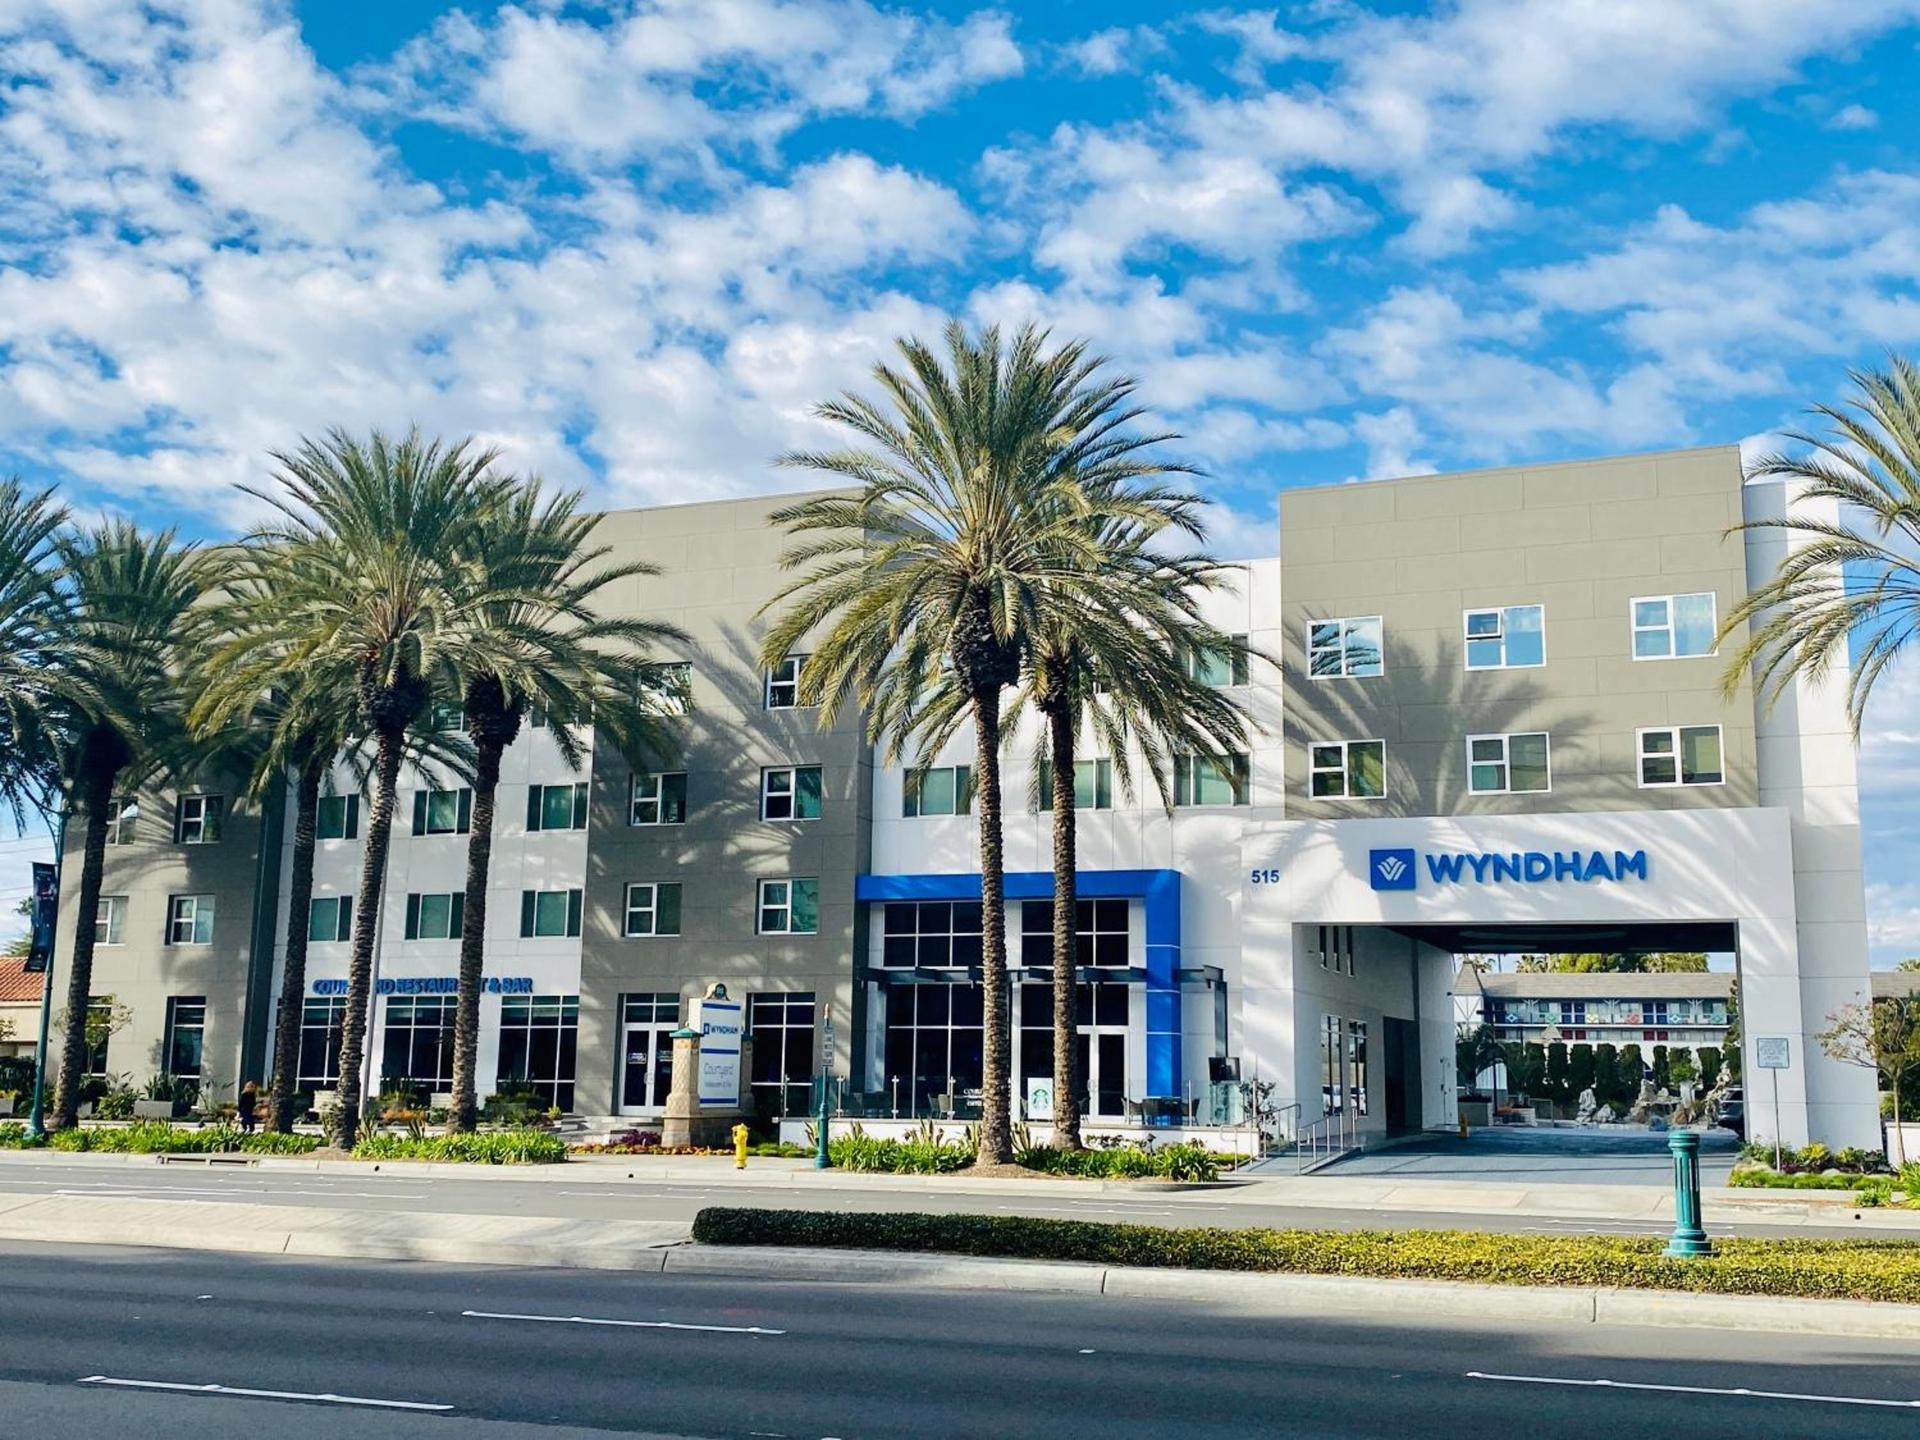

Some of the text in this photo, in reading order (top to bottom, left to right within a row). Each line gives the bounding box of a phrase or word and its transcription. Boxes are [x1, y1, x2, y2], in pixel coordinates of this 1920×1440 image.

[1425, 850, 1647, 883] WYNDHAM
[1251, 870, 1280, 885] 515
[312, 978, 533, 995] COURRD RESTAURT & BAR
[711, 1025, 738, 1034] WYNDHAM
